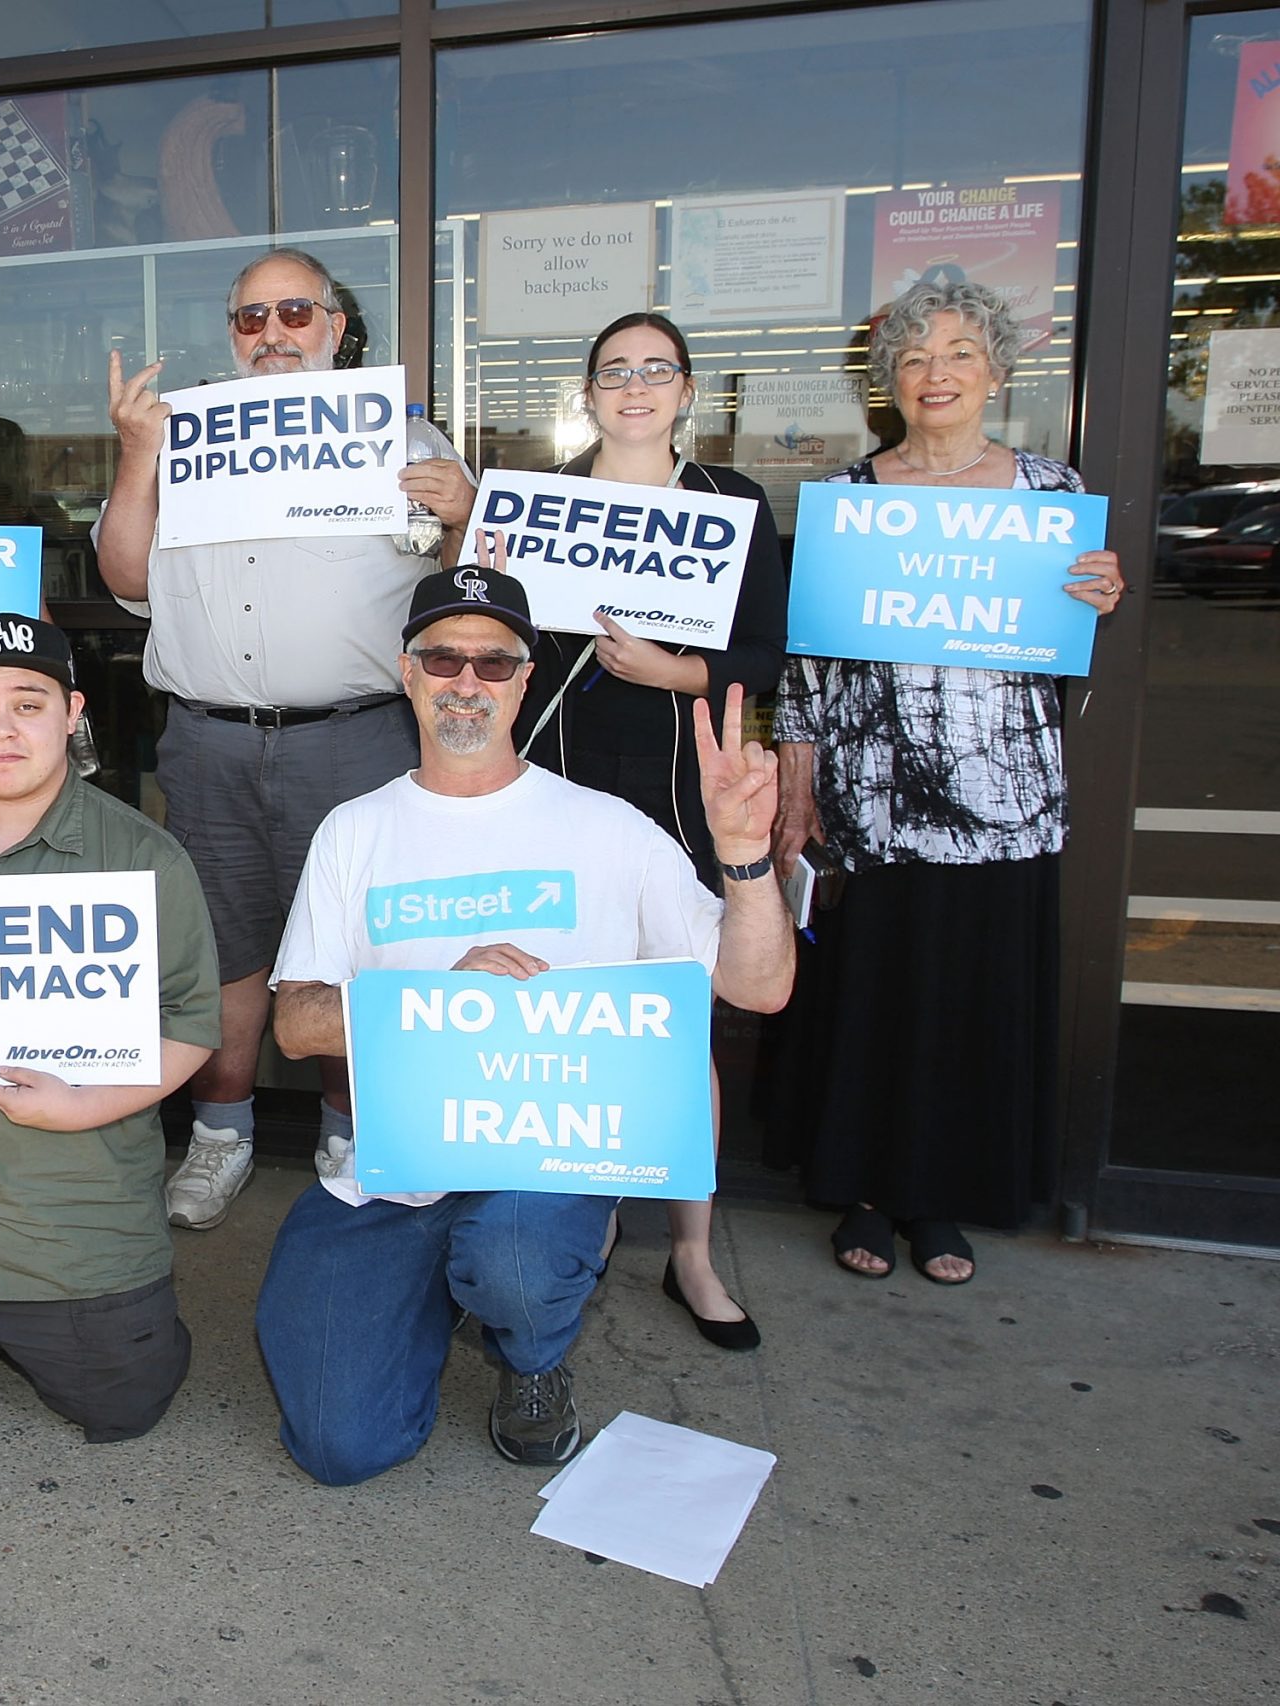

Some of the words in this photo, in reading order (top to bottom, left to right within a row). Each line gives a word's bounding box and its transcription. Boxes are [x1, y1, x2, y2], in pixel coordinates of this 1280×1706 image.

[918, 190, 955, 207] YOUR
[959, 186, 1017, 204] CHANGE
[2, 224, 9, 234] 2
[11, 224, 19, 233] in
[22, 223, 28, 232] 1
[30, 216, 64, 234] Crystal
[889, 210, 935, 226] COULD
[939, 205, 996, 223] CHANGE
[999, 205, 1010, 219] A
[1014, 203, 1045, 218] LIFE
[11, 236, 37, 249] Game
[40, 232, 55, 245] Set
[502, 235, 546, 253] Sorry
[552, 236, 576, 247] we
[581, 231, 602, 246] do
[607, 231, 633, 245] not
[544, 255, 589, 271] allow
[524, 276, 609, 297] backpacks
[1248, 367, 1267, 377] NO
[758, 382, 775, 393] CAN
[777, 381, 790, 392] NO
[793, 380, 828, 391] LONGER
[830, 379, 863, 391] ACCEPT
[741, 394, 797, 406] TELEVISIONS
[800, 394, 812, 405] OR
[814, 392, 863, 404] COMPUTER
[171, 392, 392, 451] DEFEND
[776, 406, 824, 418] MONITORS
[1249, 416, 1280, 425] SERV
[171, 439, 394, 485] DIPLOMACY
[286, 505, 394, 518] MoveOn.ORG
[483, 490, 736, 551] DEFEND
[834, 498, 917, 536] NO
[936, 502, 1075, 544] WAR
[897, 551, 995, 580] WITH
[596, 604, 715, 629] MoveOn.ORG
[862, 588, 1022, 635] IRAN!
[373, 898, 392, 929] J
[399, 885, 513, 924] Street
[401, 988, 495, 1033] NO
[515, 990, 671, 1039] WAR
[6, 1045, 141, 1060] MoveOn.ORG
[477, 1052, 588, 1084] WITH
[442, 1098, 622, 1150] IRAN!
